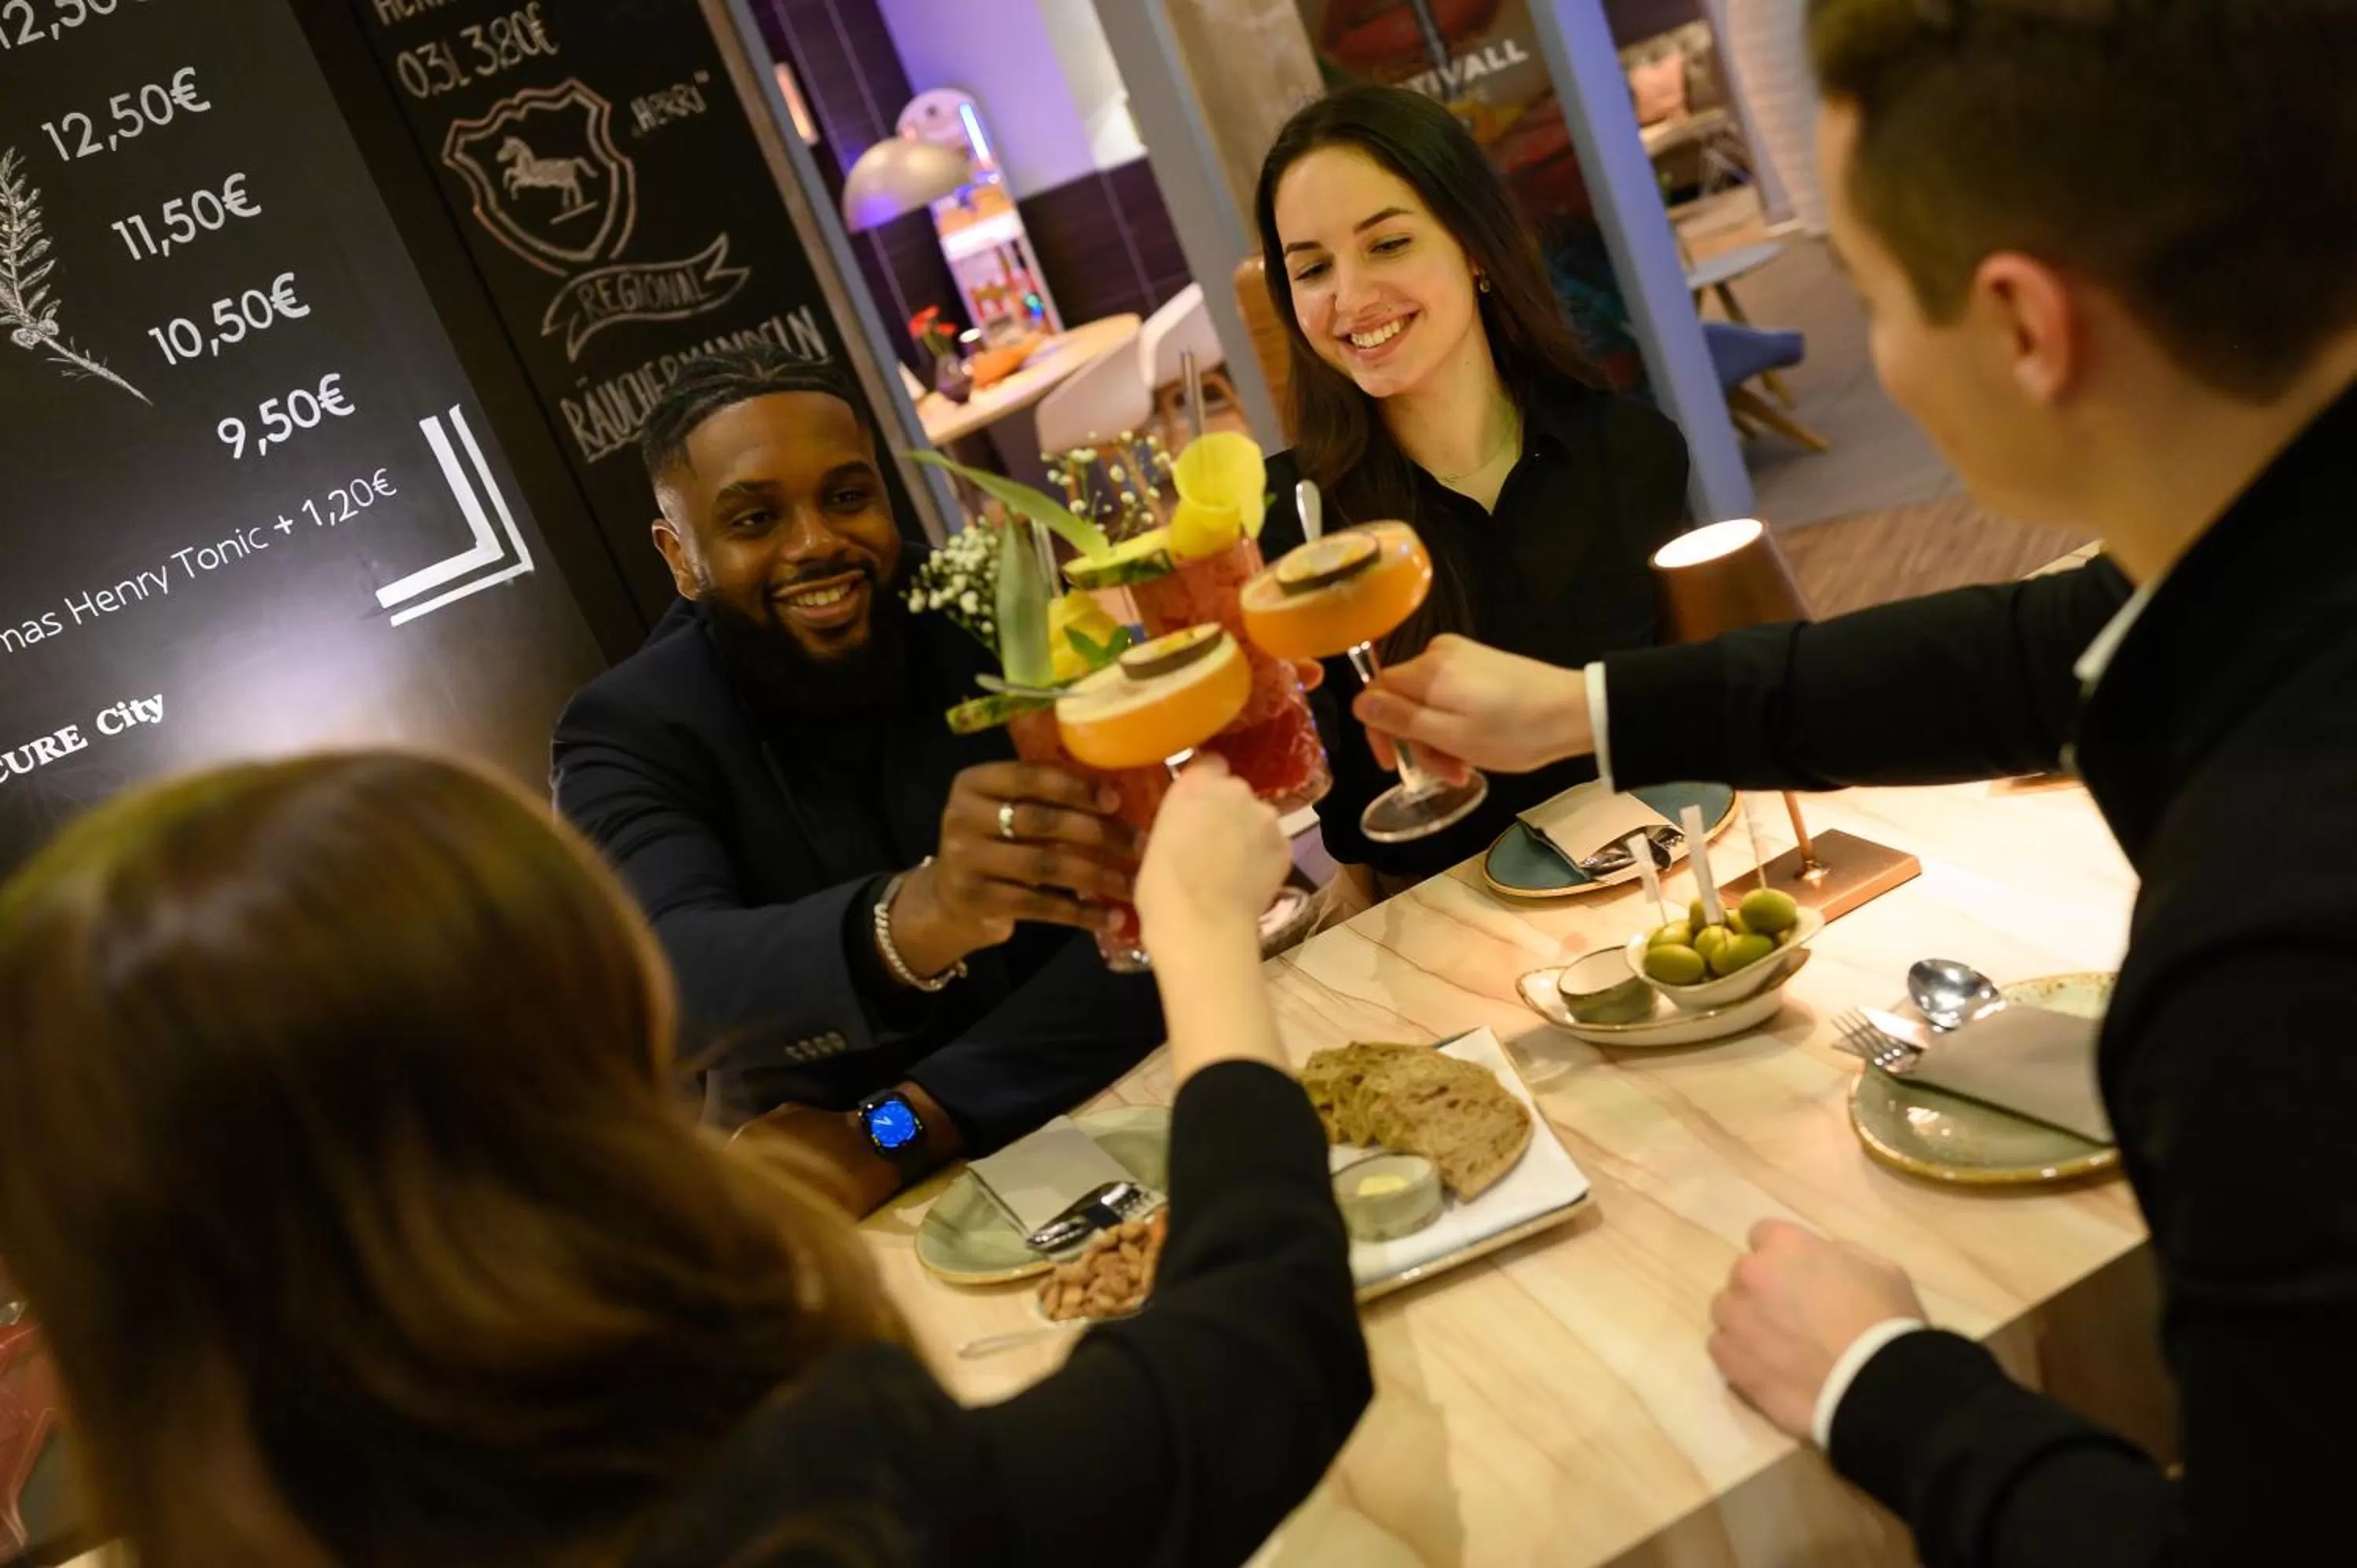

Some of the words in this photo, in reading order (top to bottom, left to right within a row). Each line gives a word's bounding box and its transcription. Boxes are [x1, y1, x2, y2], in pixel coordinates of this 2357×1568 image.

[0, 0, 148, 49] 12,5
[1392, 38, 1529, 95] TIVALL
[42, 67, 211, 161] 12,50€
[112, 173, 262, 261] 11,50€
[148, 272, 310, 365] 10,50€
[577, 266, 712, 316] REGIONAL
[217, 372, 355, 459] 9,50€
[64, 564, 169, 625] Henry
[170, 525, 269, 580] Tonic
[273, 515, 294, 536] +
[302, 468, 398, 527] 1,20€
[96, 694, 163, 735] City
